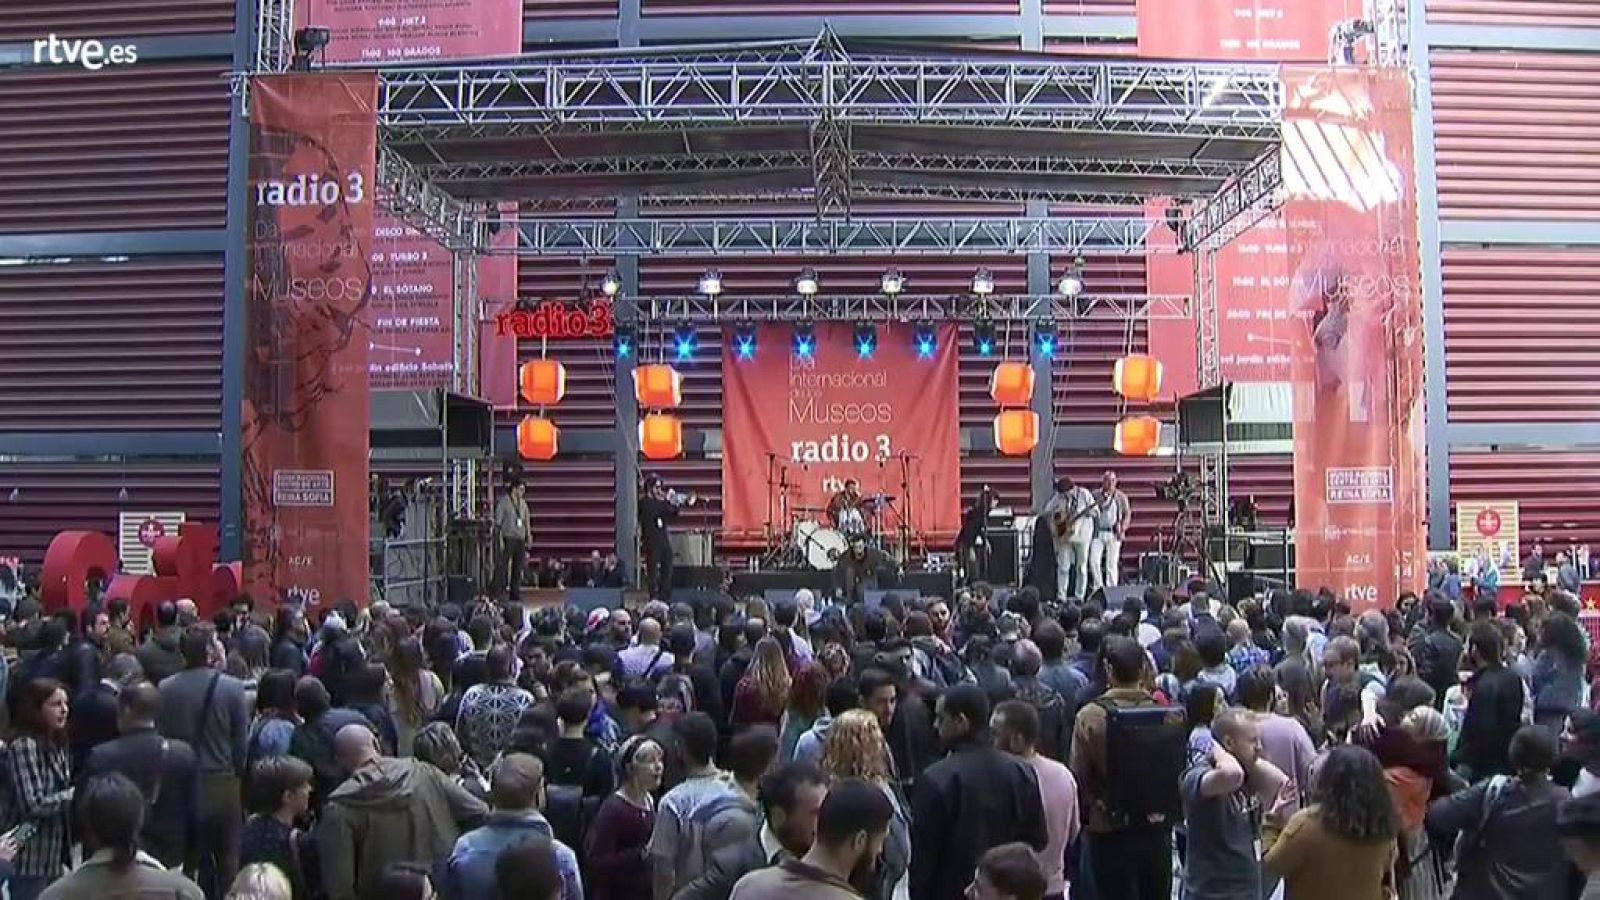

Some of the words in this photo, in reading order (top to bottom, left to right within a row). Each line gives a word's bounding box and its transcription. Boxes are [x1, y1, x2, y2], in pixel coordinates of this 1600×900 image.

[256, 174, 341, 206] radio
[344, 172, 364, 204] 3
[253, 272, 362, 301] Museos
[789, 369, 887, 388] Internacional
[788, 397, 892, 424] Museos
[791, 434, 870, 463] radio
[875, 434, 891, 463] 3
[1344, 583, 1378, 603] rtve
